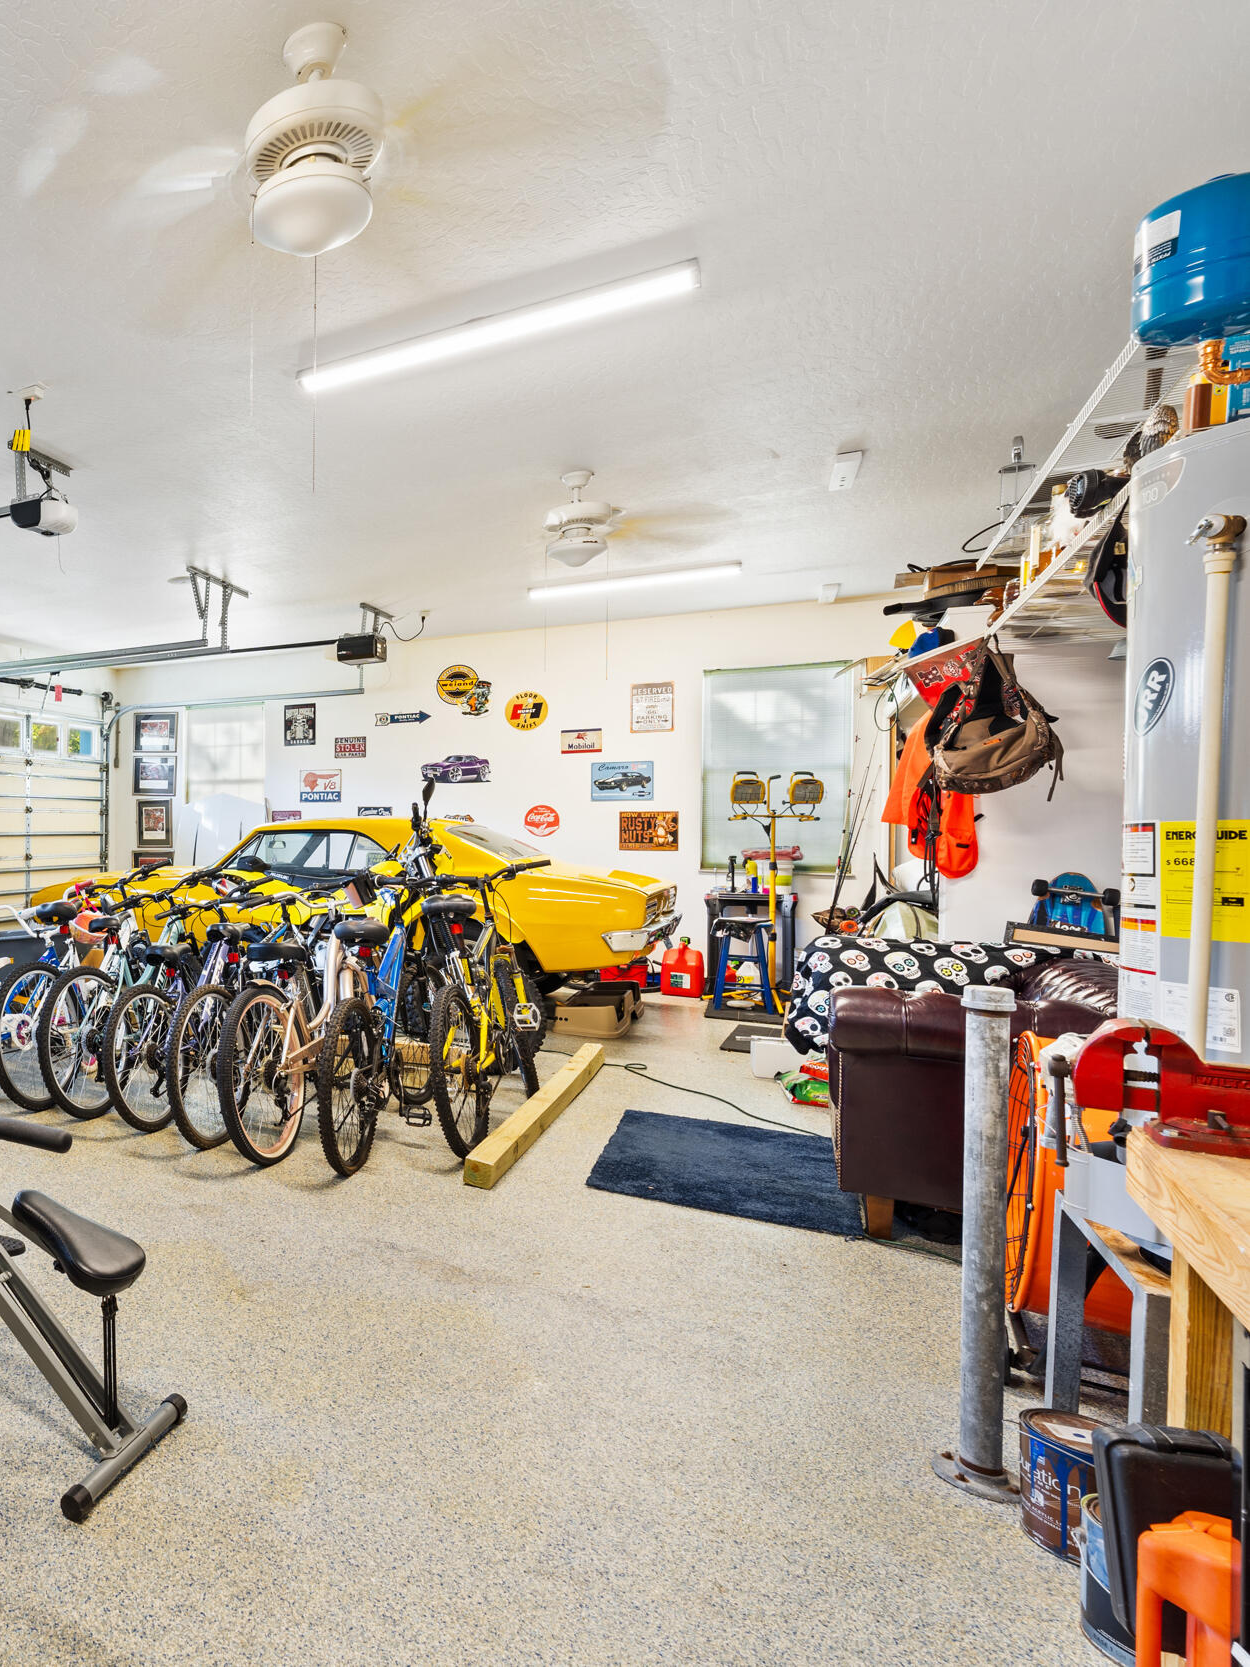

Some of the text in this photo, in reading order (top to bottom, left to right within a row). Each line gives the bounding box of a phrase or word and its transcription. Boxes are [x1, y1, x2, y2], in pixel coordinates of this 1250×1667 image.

[632, 687, 673, 696] RESERVED
[515, 692, 538, 700] FLOOR
[516, 721, 538, 729] SHIFT
[335, 744, 365, 752] STOLEN
[323, 779, 337, 791] V8
[301, 793, 339, 801] PONTIAC
[621, 818, 657, 830] RUSTY
[621, 830, 650, 843] NUTS
